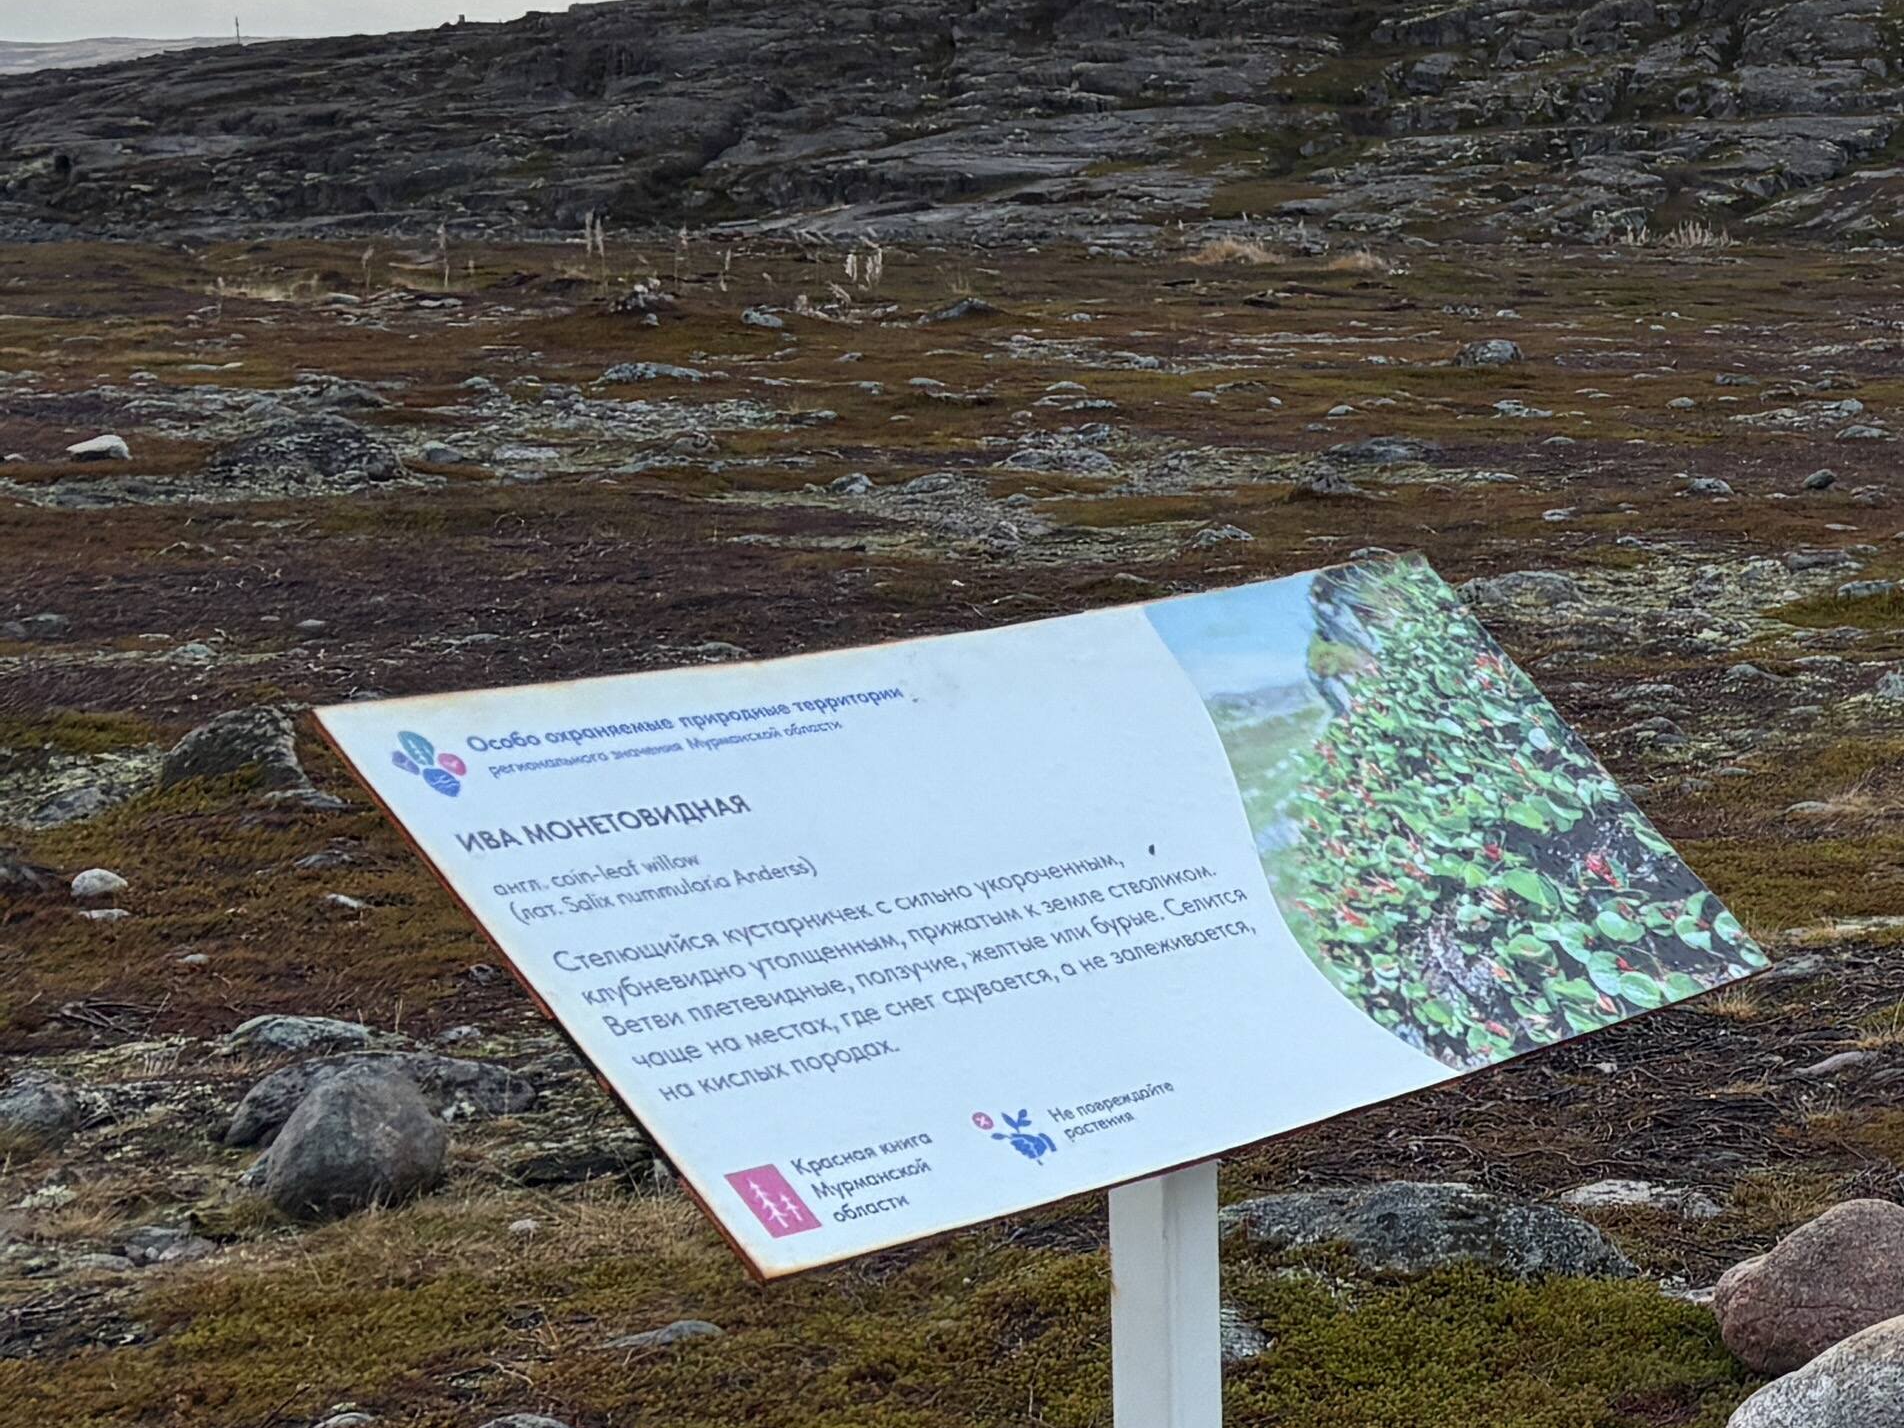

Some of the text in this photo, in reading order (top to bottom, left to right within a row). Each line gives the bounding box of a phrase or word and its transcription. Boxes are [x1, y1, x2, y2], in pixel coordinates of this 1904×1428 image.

[467, 686, 904, 753] Особо охраняемые природные территории
[612, 742, 683, 759] значения
[687, 727, 781, 751] Мурманской
[784, 719, 842, 739] области
[455, 795, 751, 854] ИВА МОНЕТОВИДНАЯ
[493, 855, 700, 896] англ. coin-leaf willow
[510, 856, 818, 925] (лат. Salix nummularia Anderss)
[553, 853, 1125, 973] Стелющийся кустарничек с сильно укороченным,
[581, 864, 1216, 1006] клубневидно утолщенным, прижатым к земле стволиком.
[602, 888, 1247, 1037] Ветви плетевидные, ползучие, желтые или бурые. Селится
[632, 919, 1257, 1069] чаще на местах, где снег сдувается, а не залеживается,
[659, 1036, 900, 1101] на кислых породах.
[1048, 1081, 1175, 1123] Не повреждайте
[1063, 1111, 1134, 1140] растения
[791, 1132, 934, 1176] Красная книга
[811, 1159, 932, 1200] Мурманской
[833, 1193, 910, 1223] области
